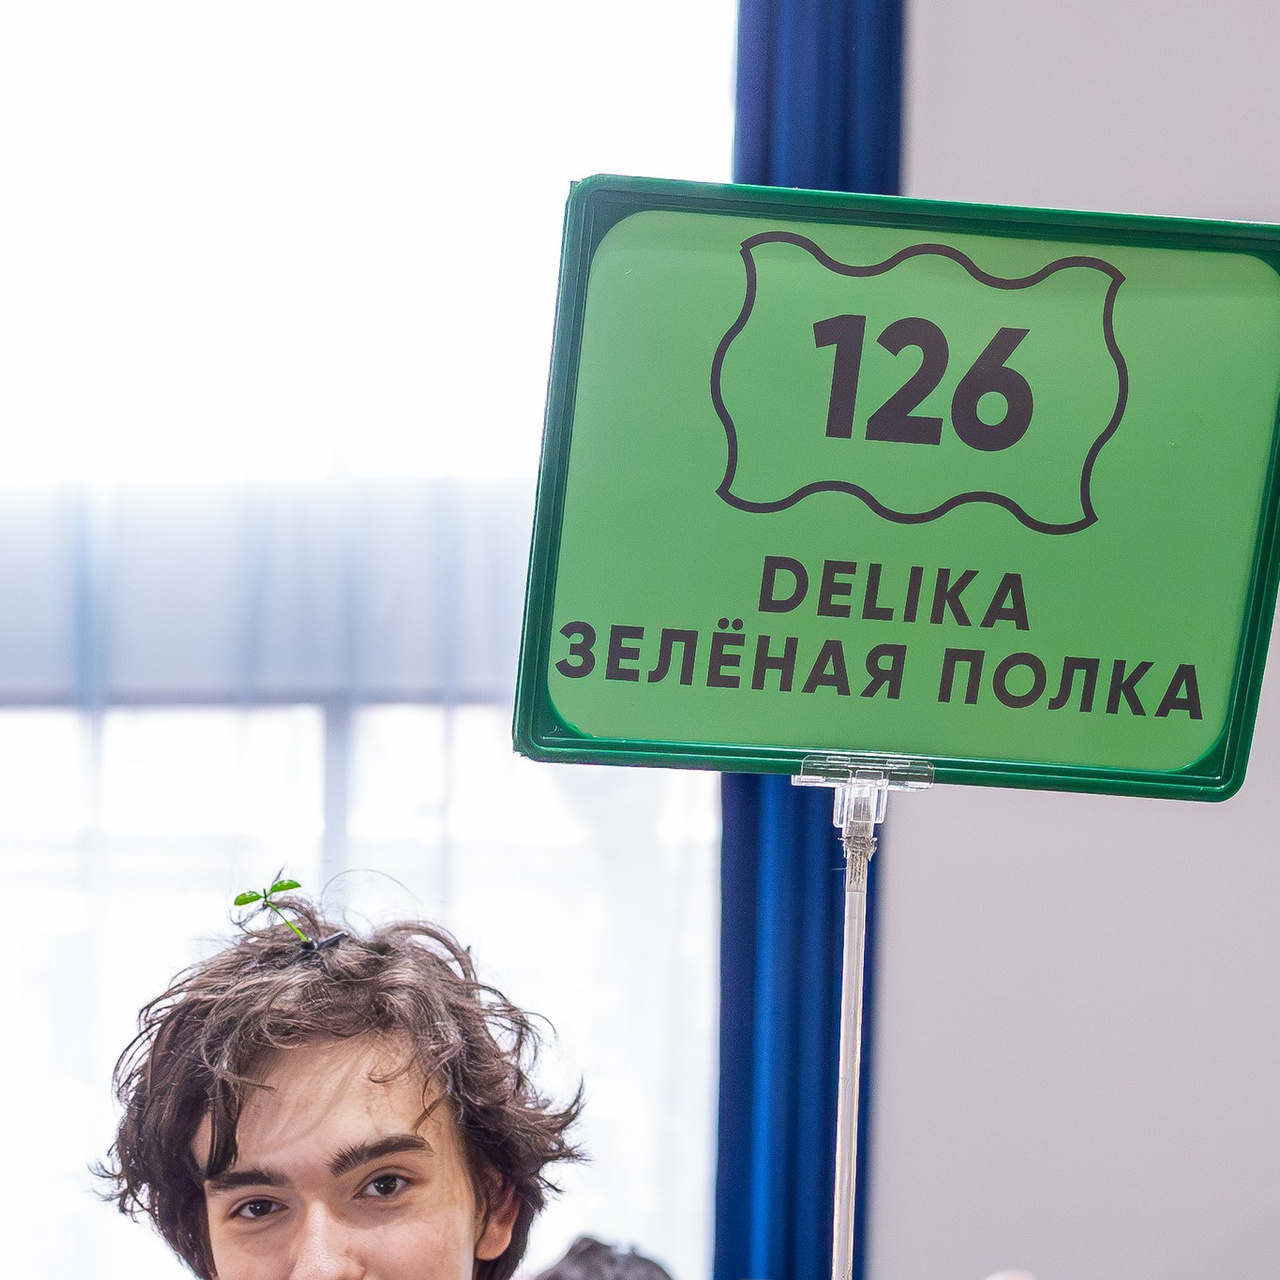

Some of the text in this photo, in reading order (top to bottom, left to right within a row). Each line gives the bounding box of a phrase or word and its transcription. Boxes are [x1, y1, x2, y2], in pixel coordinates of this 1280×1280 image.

[813, 314, 1034, 452] 126
[758, 555, 1030, 631] DELIKA
[555, 617, 1204, 721] ЗЕЛЁНАЯ ПОЛКА
